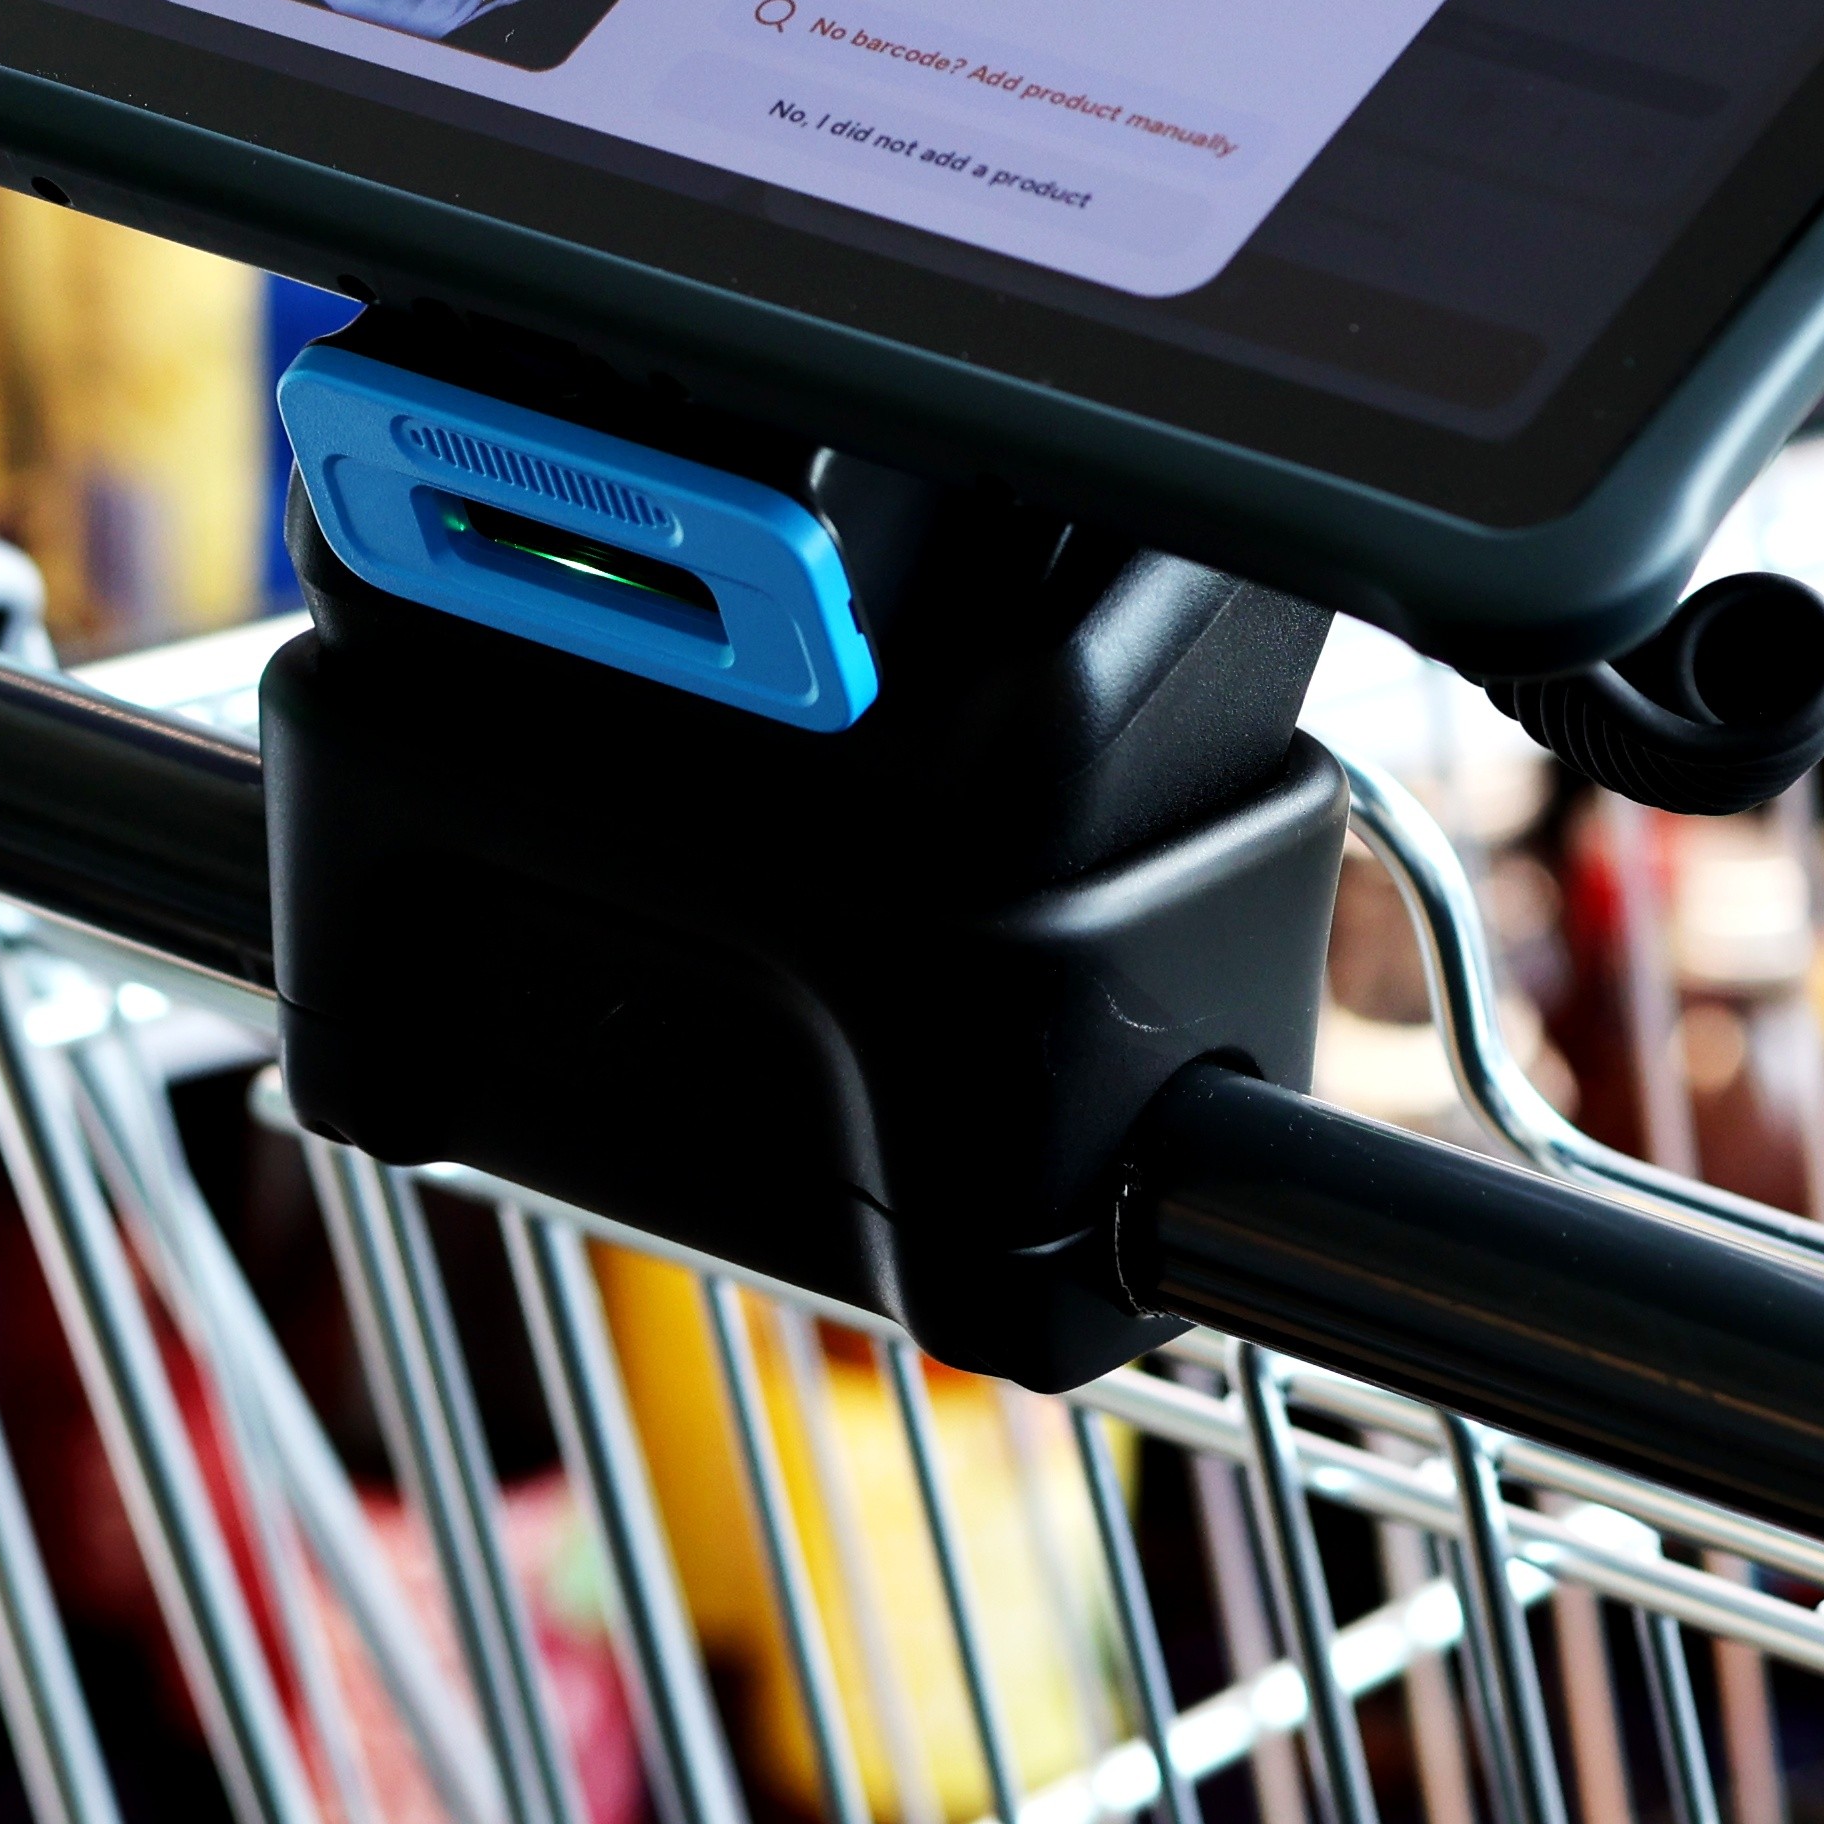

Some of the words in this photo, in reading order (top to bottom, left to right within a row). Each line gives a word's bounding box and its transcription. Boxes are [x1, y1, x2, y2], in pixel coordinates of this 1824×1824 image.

[808, 17, 847, 41] No
[849, 28, 968, 75] barcode?
[967, 65, 1024, 92] Add
[1018, 82, 1124, 123] product
[1125, 113, 1240, 159] manually
[768, 99, 809, 128] No,
[815, 113, 831, 131] I
[829, 119, 875, 144] did
[872, 134, 919, 158] not
[919, 150, 972, 173] add
[971, 163, 989, 178] a
[987, 169, 1094, 210] product
